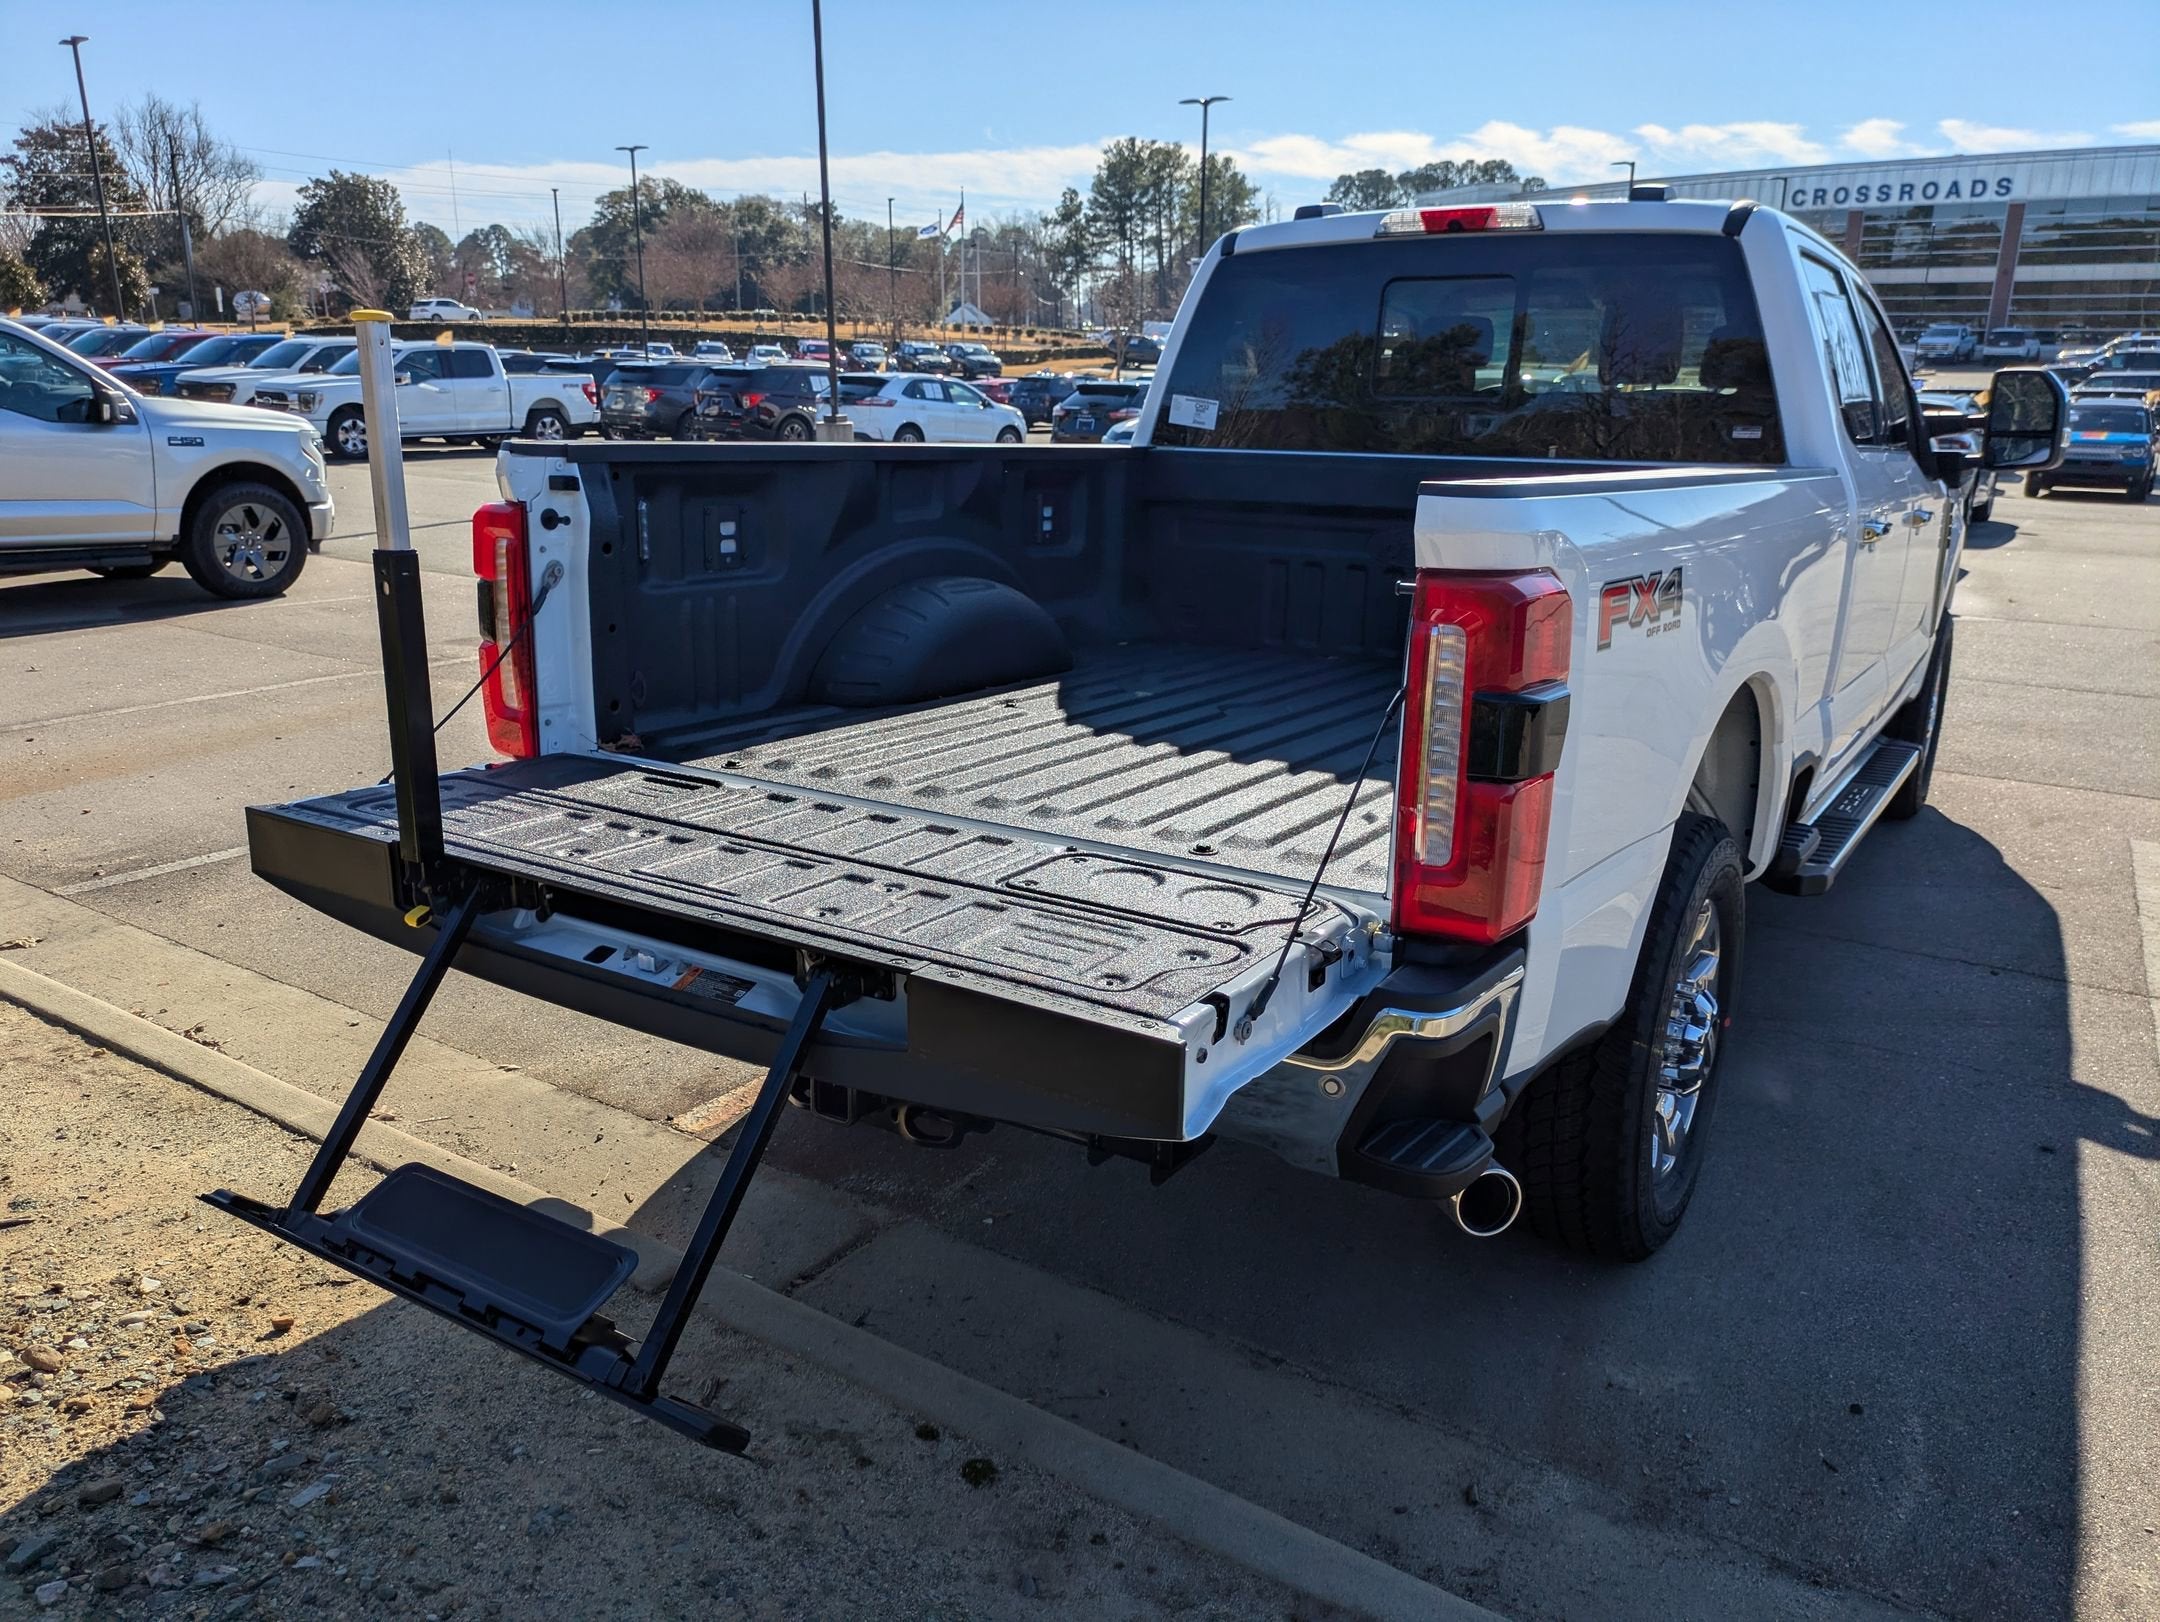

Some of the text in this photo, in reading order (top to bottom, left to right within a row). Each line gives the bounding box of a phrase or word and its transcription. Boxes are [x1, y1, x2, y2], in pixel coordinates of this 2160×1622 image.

[1791, 177, 2014, 207] CROSSROADS
[1597, 566, 1683, 653] FX4
[1646, 619, 1681, 638] OFF ROAD
